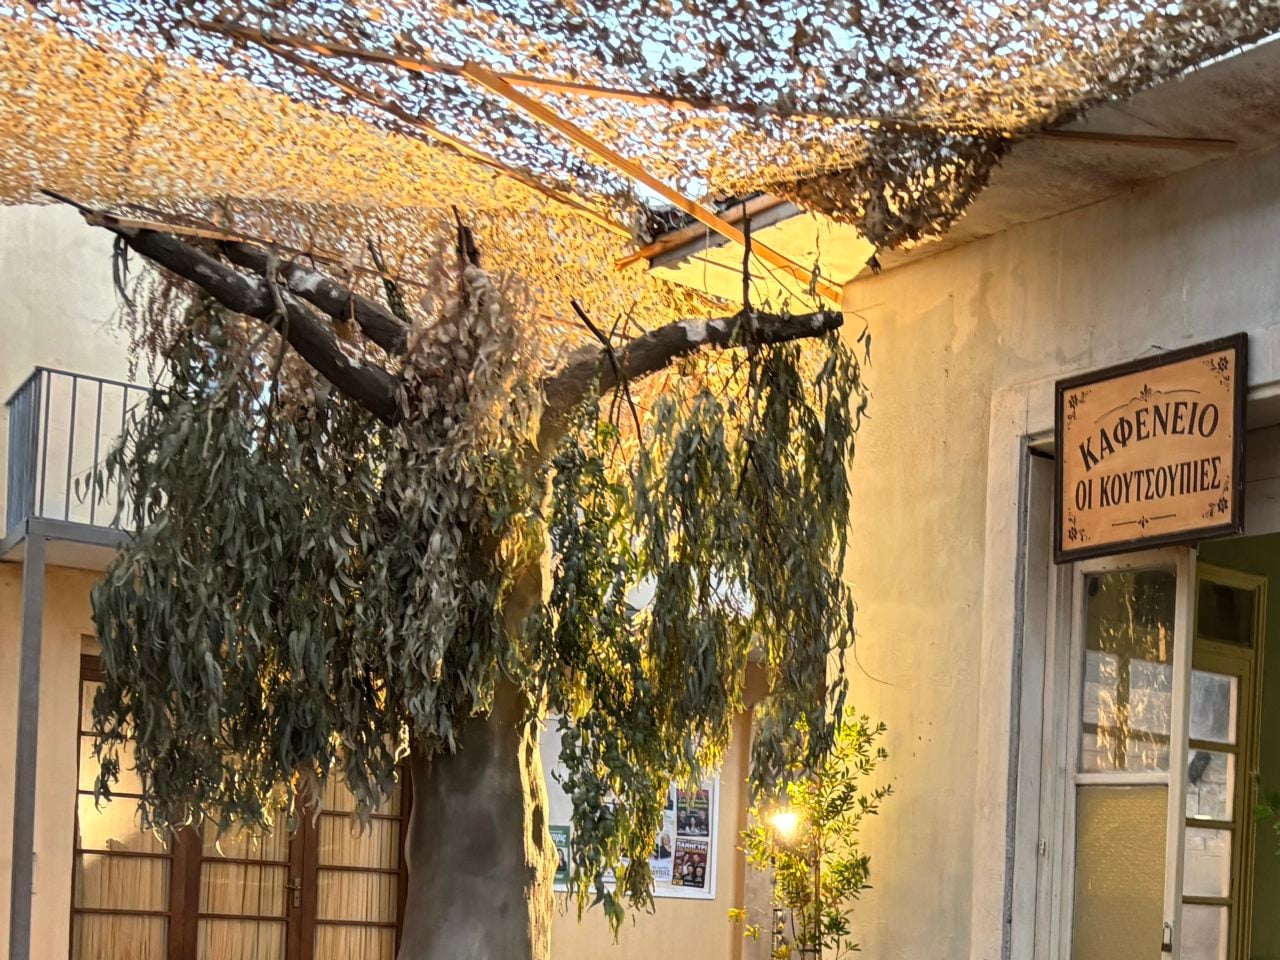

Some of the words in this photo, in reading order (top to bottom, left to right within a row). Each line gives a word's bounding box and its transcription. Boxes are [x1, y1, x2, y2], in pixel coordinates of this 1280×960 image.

[1078, 401, 1219, 472] ΚΑΦΕΝΕΙΟ
[1075, 478, 1093, 511] ΟΙ
[1099, 456, 1222, 508] ΚΟΥΤΣΟΥΠΙΕΣ
